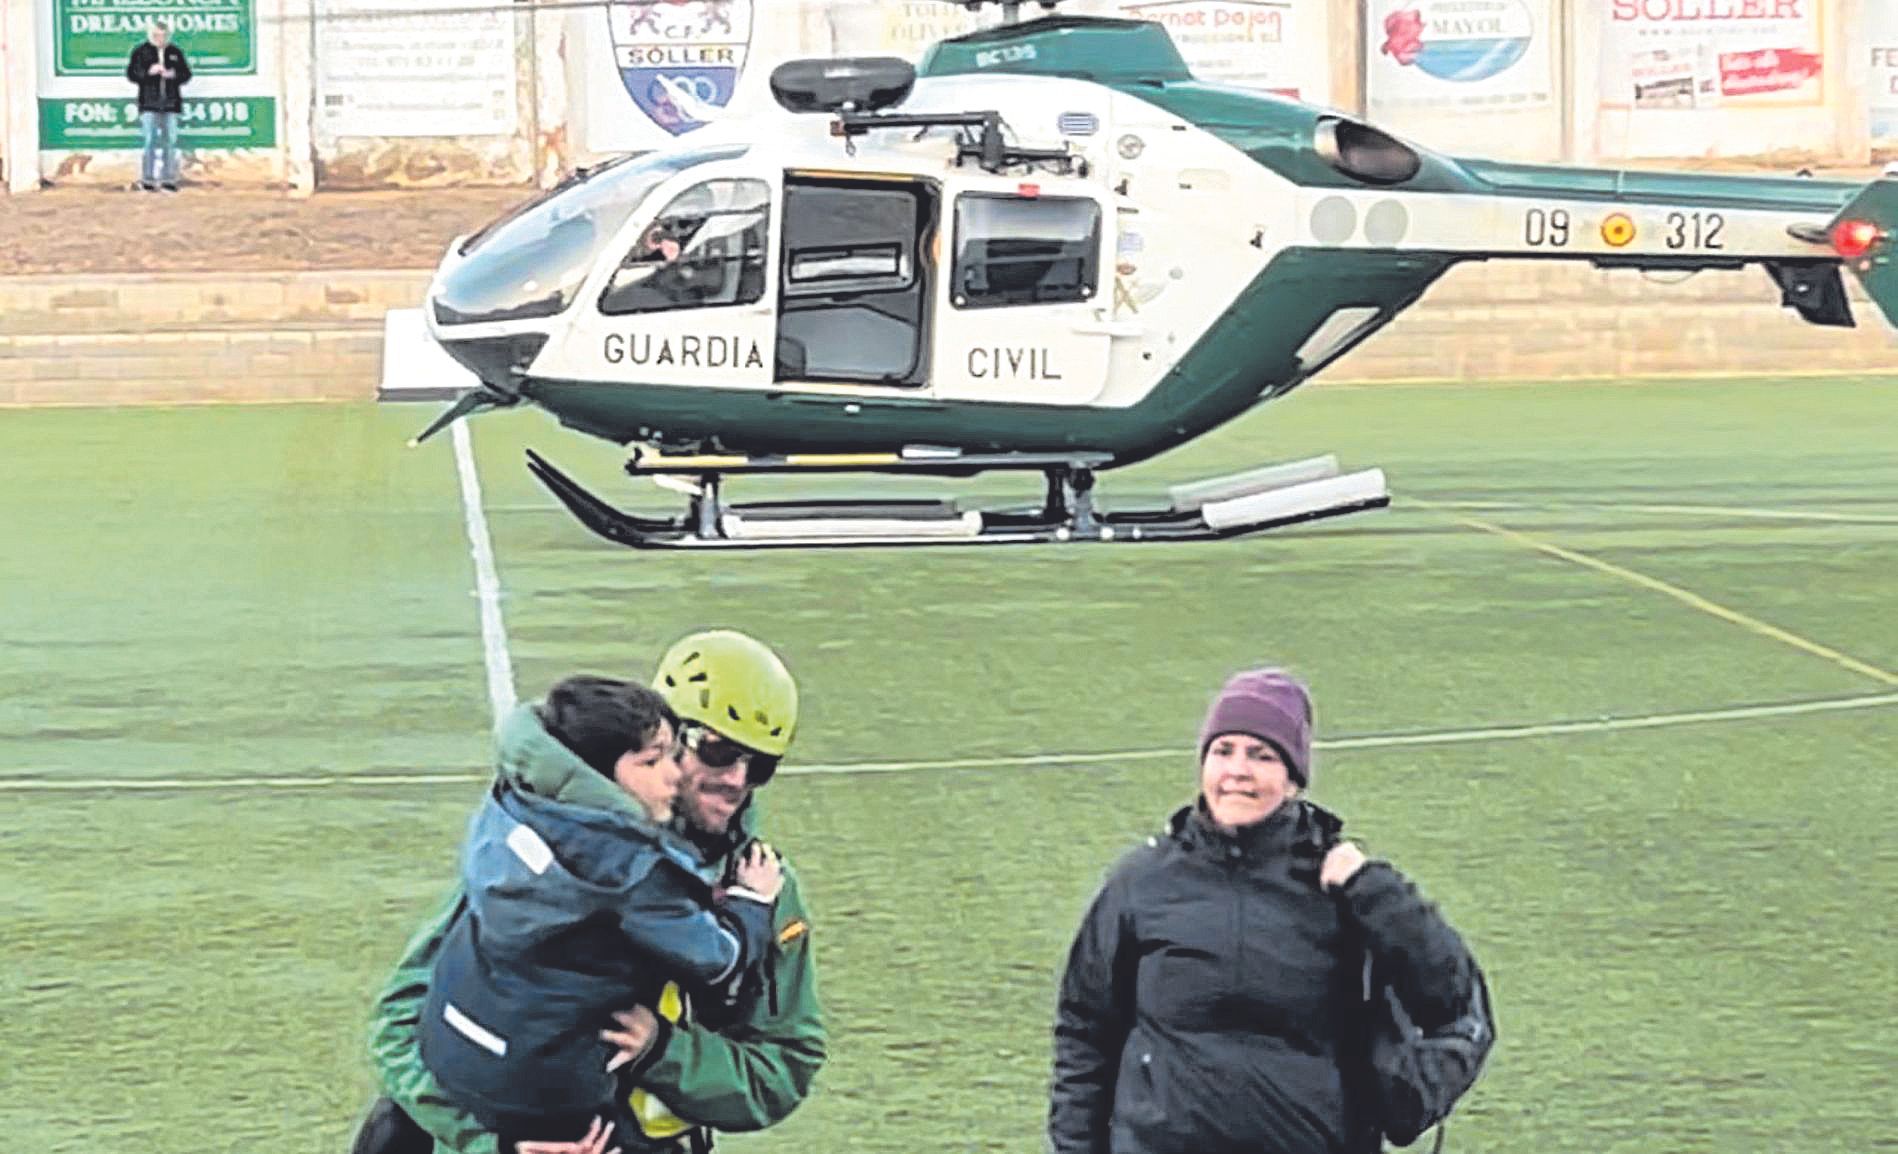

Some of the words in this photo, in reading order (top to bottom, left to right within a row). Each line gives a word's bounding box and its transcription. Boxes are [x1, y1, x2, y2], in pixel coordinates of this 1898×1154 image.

[71, 14, 152, 33] DREAM
[64, 102, 117, 123] FON:
[1525, 208, 1569, 248] 09
[1666, 212, 1725, 250] 312
[604, 333, 764, 369] GUARDIA
[968, 347, 1063, 380] CIVIL
